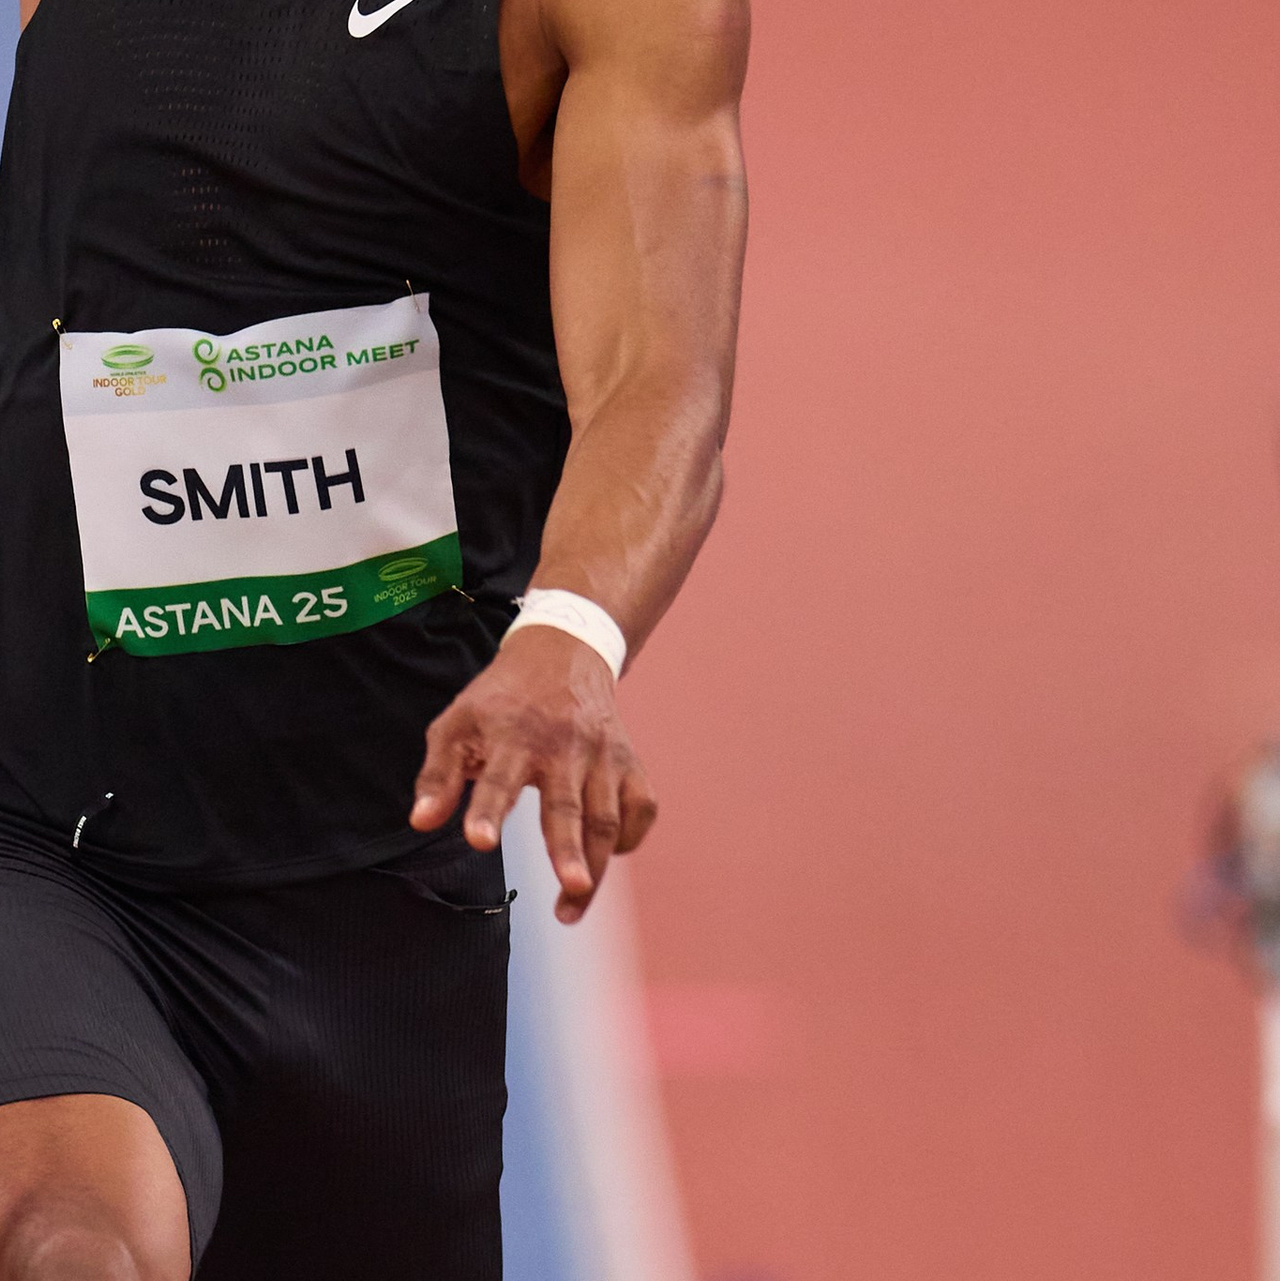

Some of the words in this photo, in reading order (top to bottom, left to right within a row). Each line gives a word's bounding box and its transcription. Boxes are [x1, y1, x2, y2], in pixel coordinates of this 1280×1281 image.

[226, 334, 335, 364] ASTANA
[229, 354, 338, 383] INDOOR
[346, 338, 421, 367] MEET
[92, 376, 135, 388] INDOOR
[137, 374, 167, 385] TOUR
[114, 385, 146, 397] GOLD
[139, 448, 366, 526] SMITH
[373, 582, 408, 603] INDOOR
[392, 588, 418, 606] 2025
[115, 594, 283, 639] ASTANA
[291, 585, 349, 624] 25
